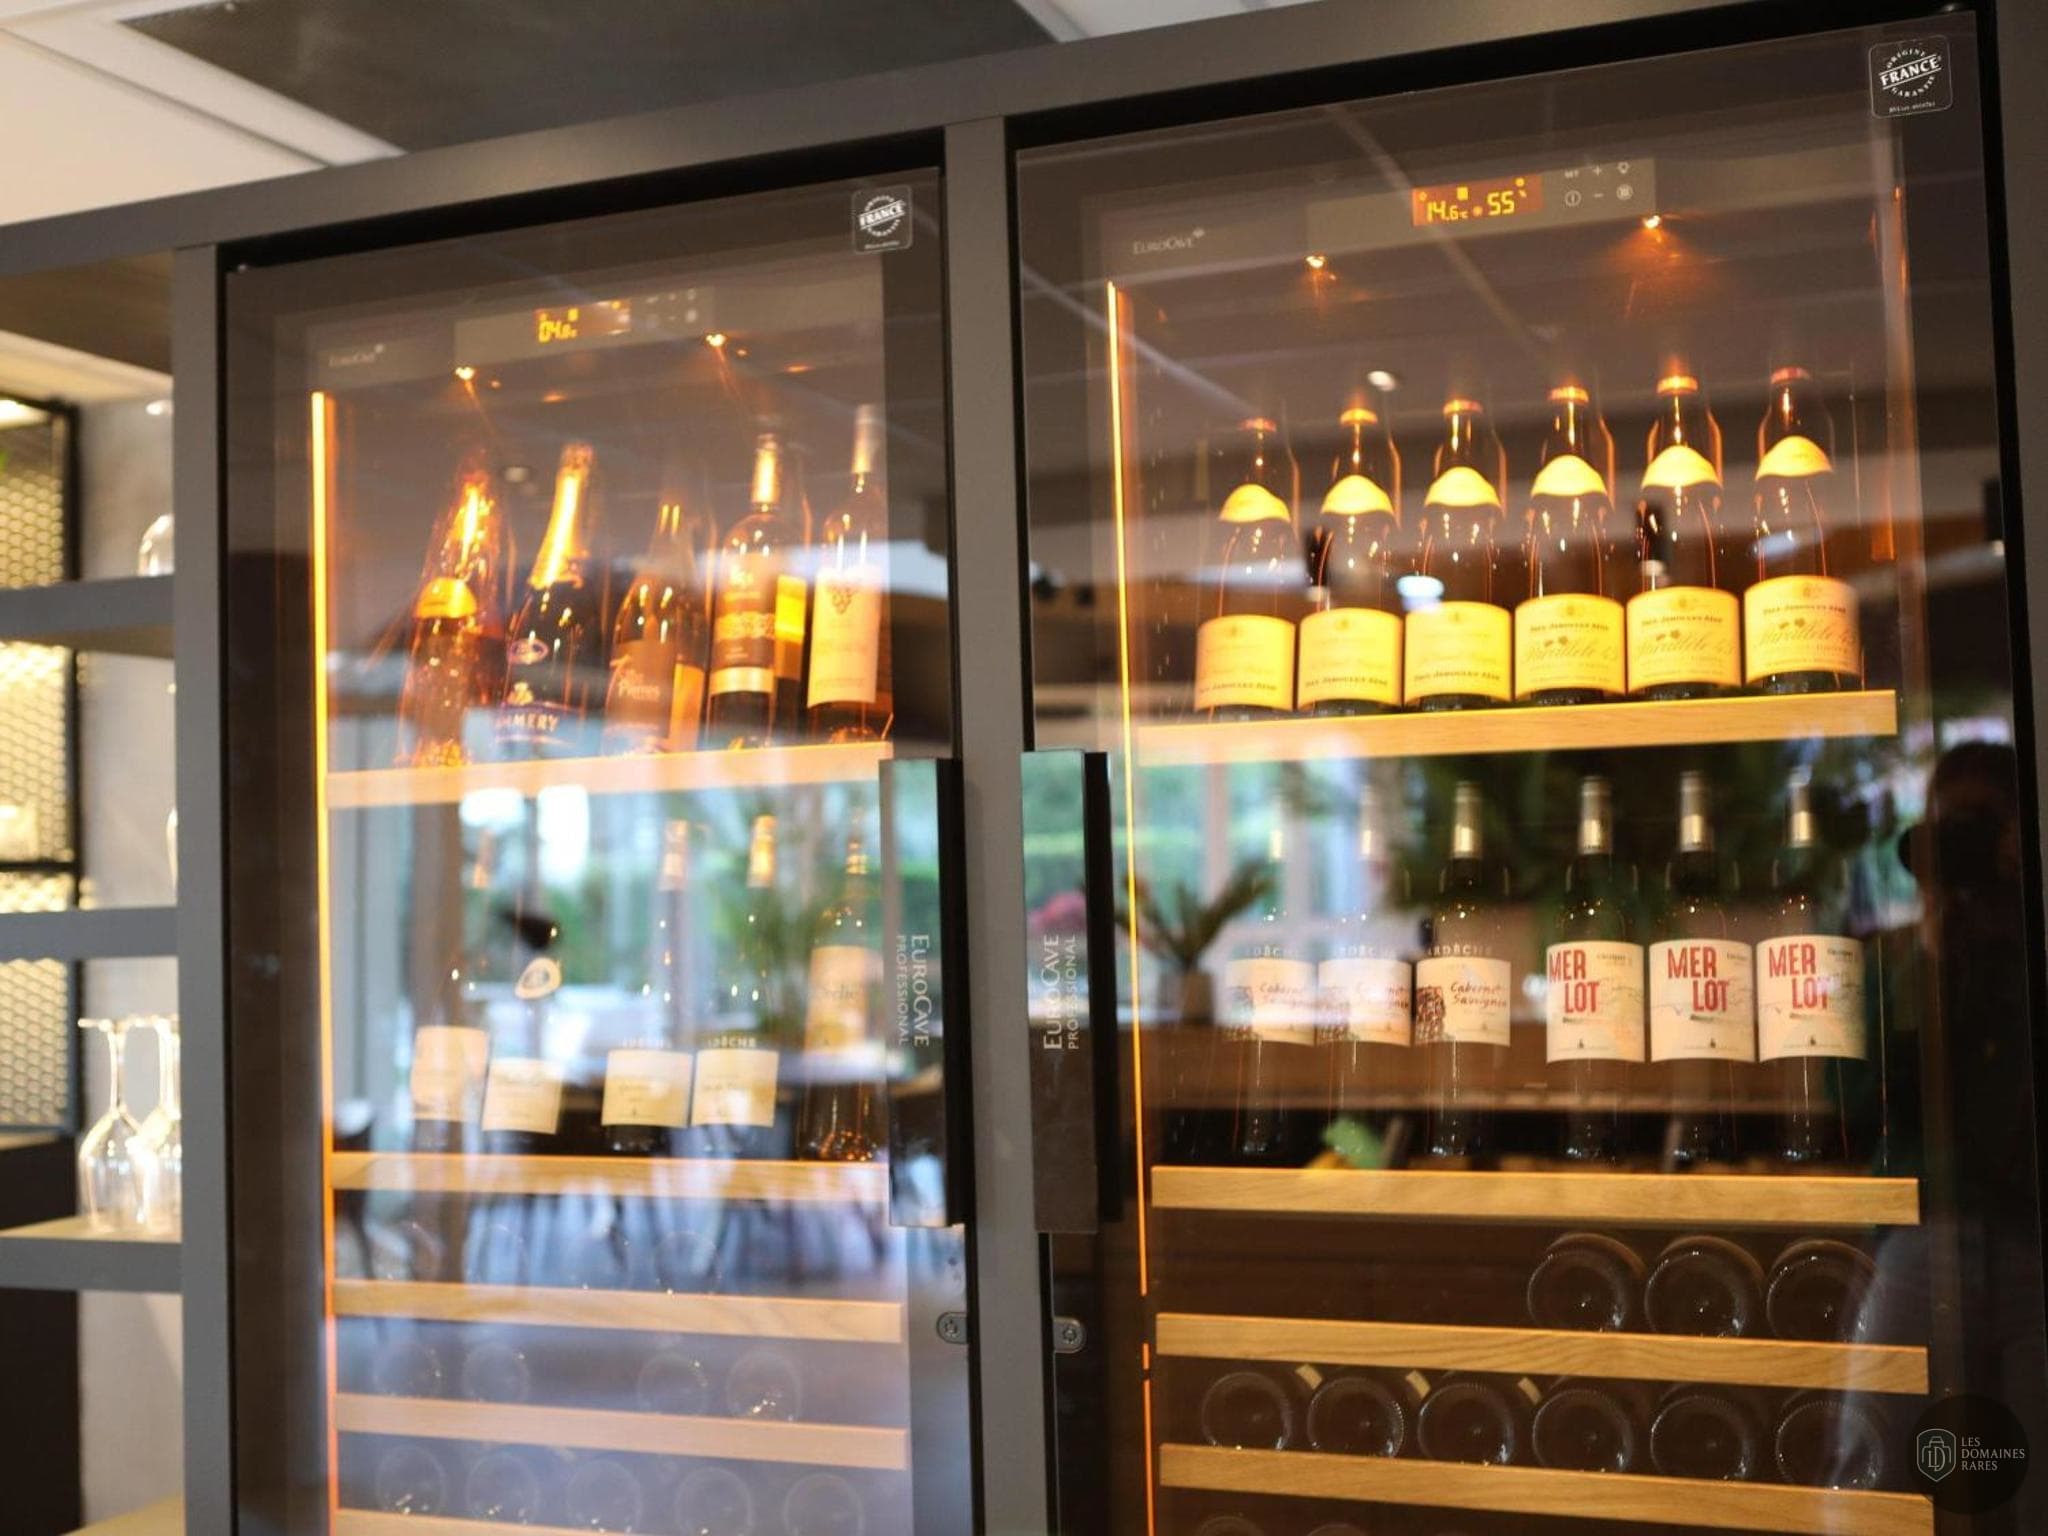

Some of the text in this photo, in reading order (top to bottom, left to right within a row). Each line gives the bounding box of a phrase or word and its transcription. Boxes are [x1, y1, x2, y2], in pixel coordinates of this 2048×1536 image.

[1880, 58, 1939, 86] FRANCE
[1550, 949, 1587, 982] MER
[1667, 946, 1717, 979] MER
[1768, 943, 1817, 977] MER
[896, 934, 909, 1045] PROFESSIONAL
[1564, 981, 1600, 1013] LOT
[1692, 980, 1730, 1012] LOT
[1791, 977, 1830, 1009] LOT
